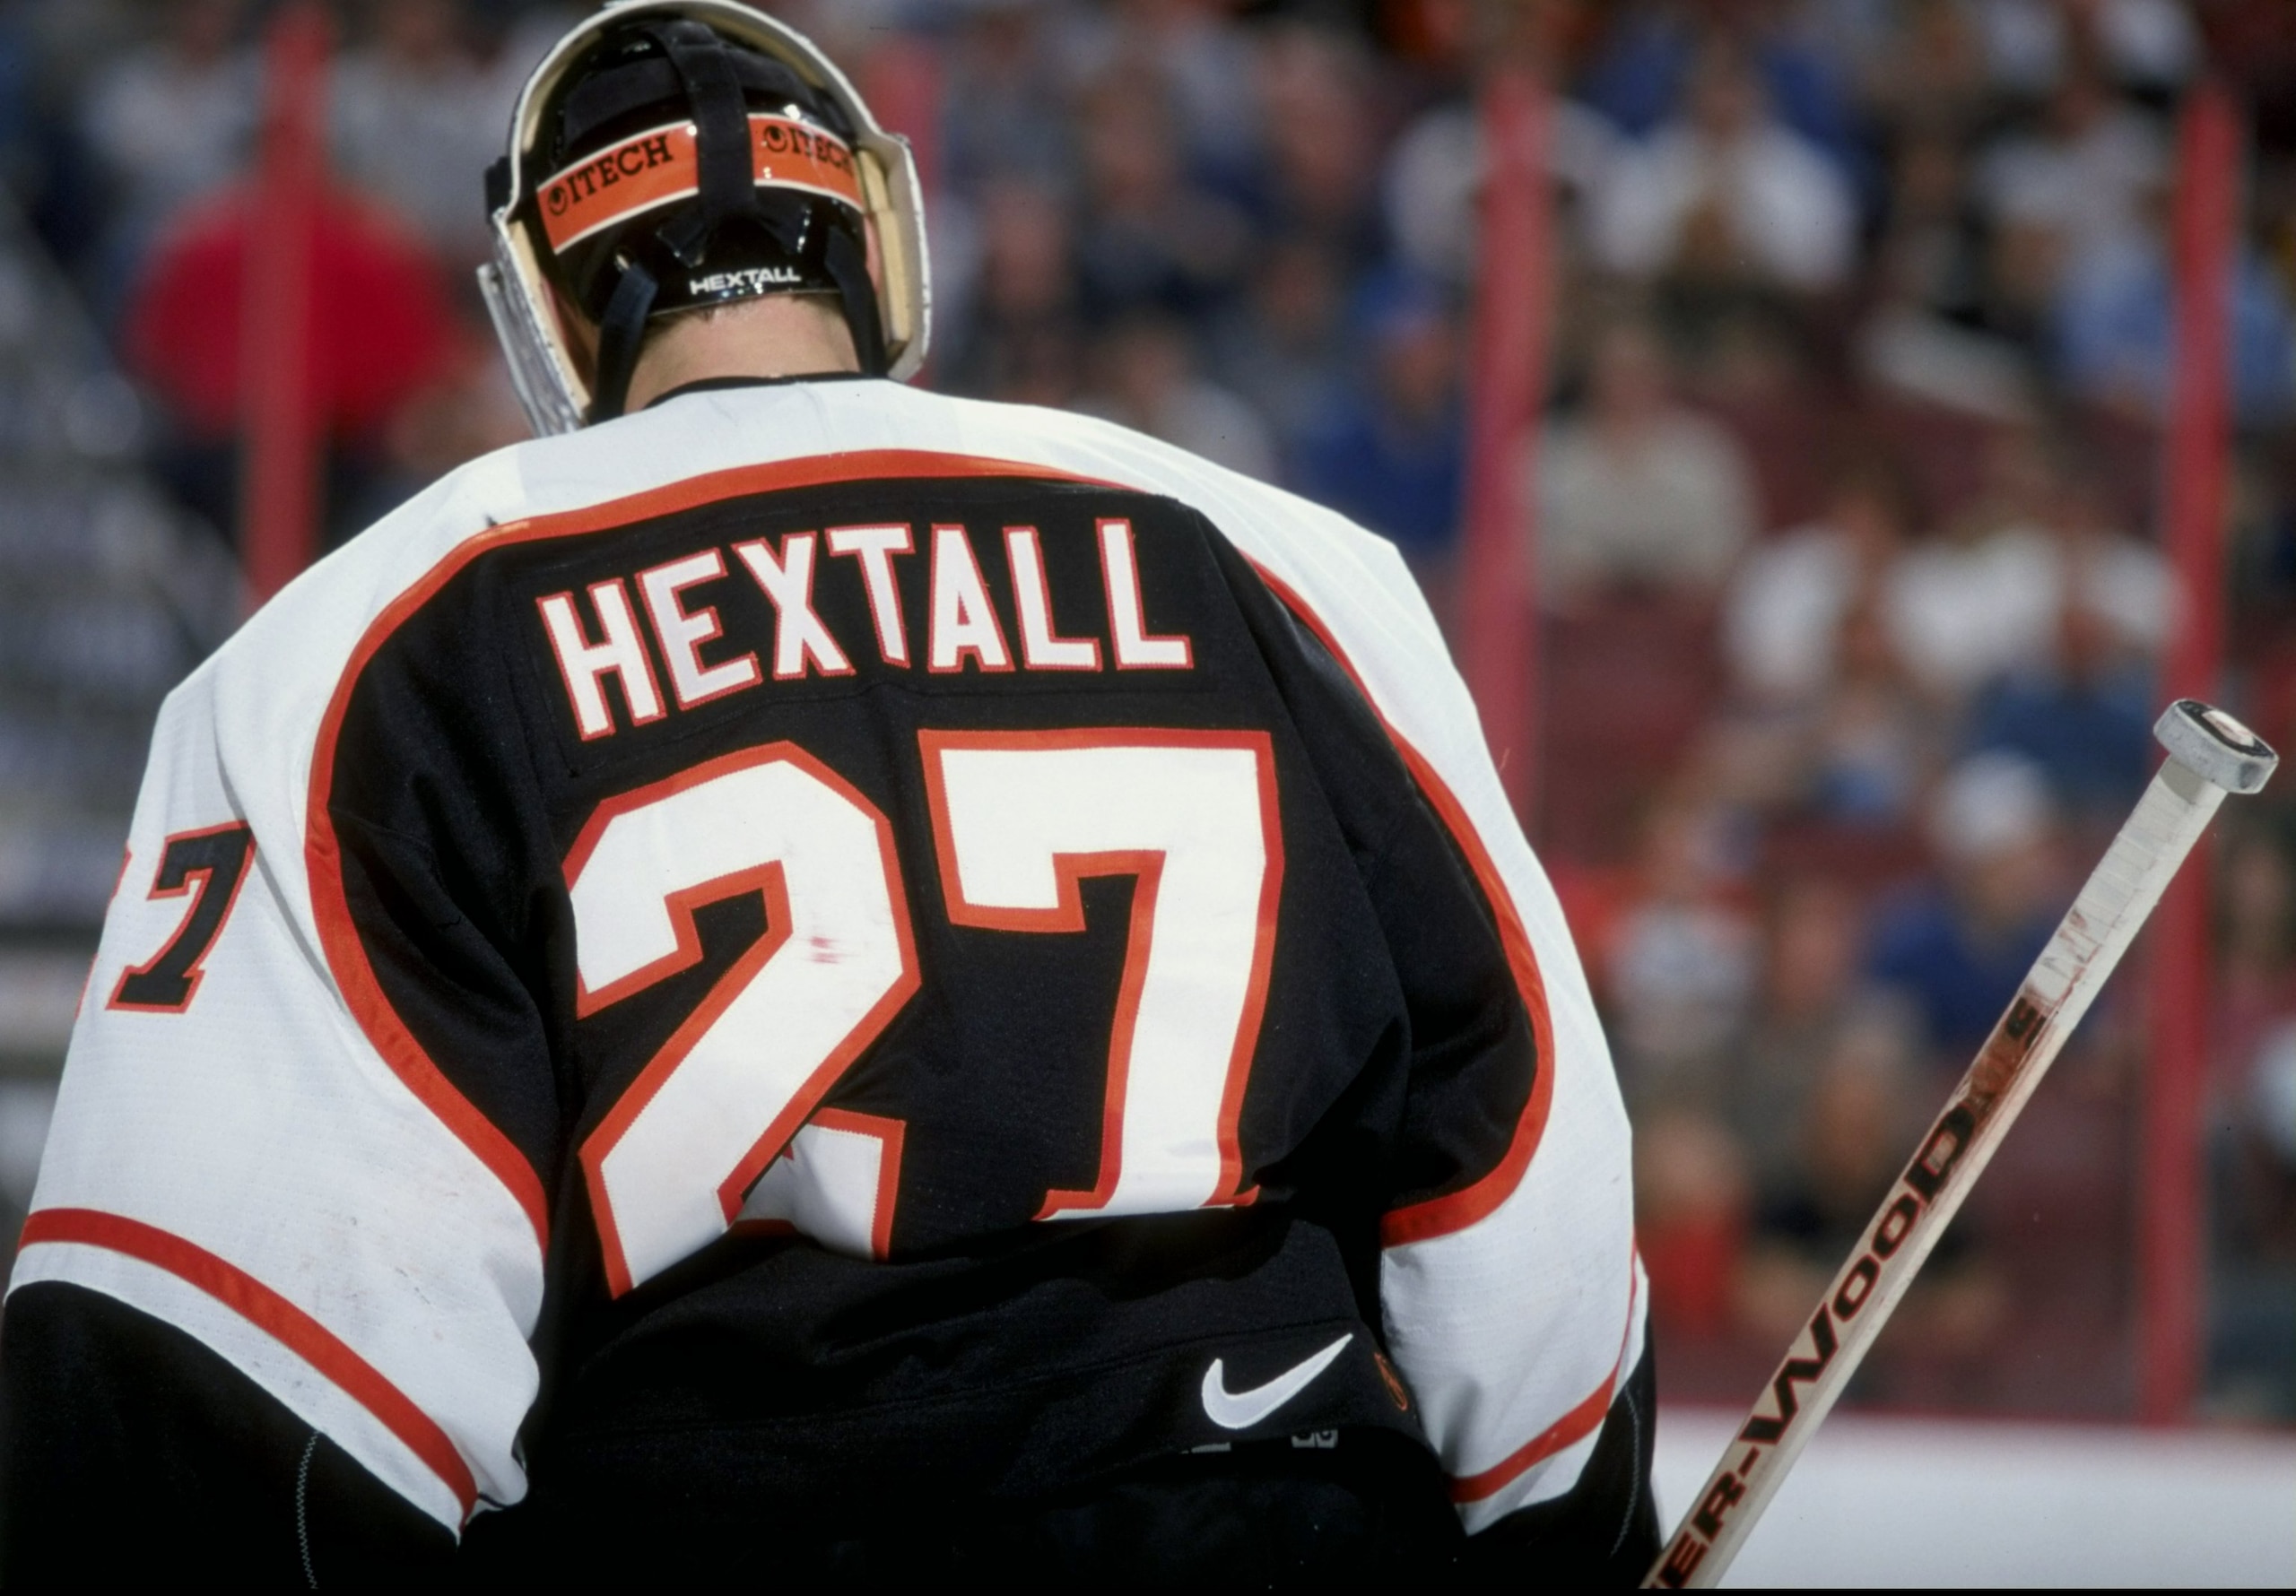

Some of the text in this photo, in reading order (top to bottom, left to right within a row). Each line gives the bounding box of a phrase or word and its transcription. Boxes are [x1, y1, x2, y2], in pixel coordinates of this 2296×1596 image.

[566, 135, 674, 204] ITECH
[690, 266, 802, 295] HEXTALL
[536, 517, 1195, 742] HEXTALL
[75, 820, 257, 1014] 7
[561, 727, 1286, 1301] 27
[1650, 1101, 1976, 1589] ER-WOOD
